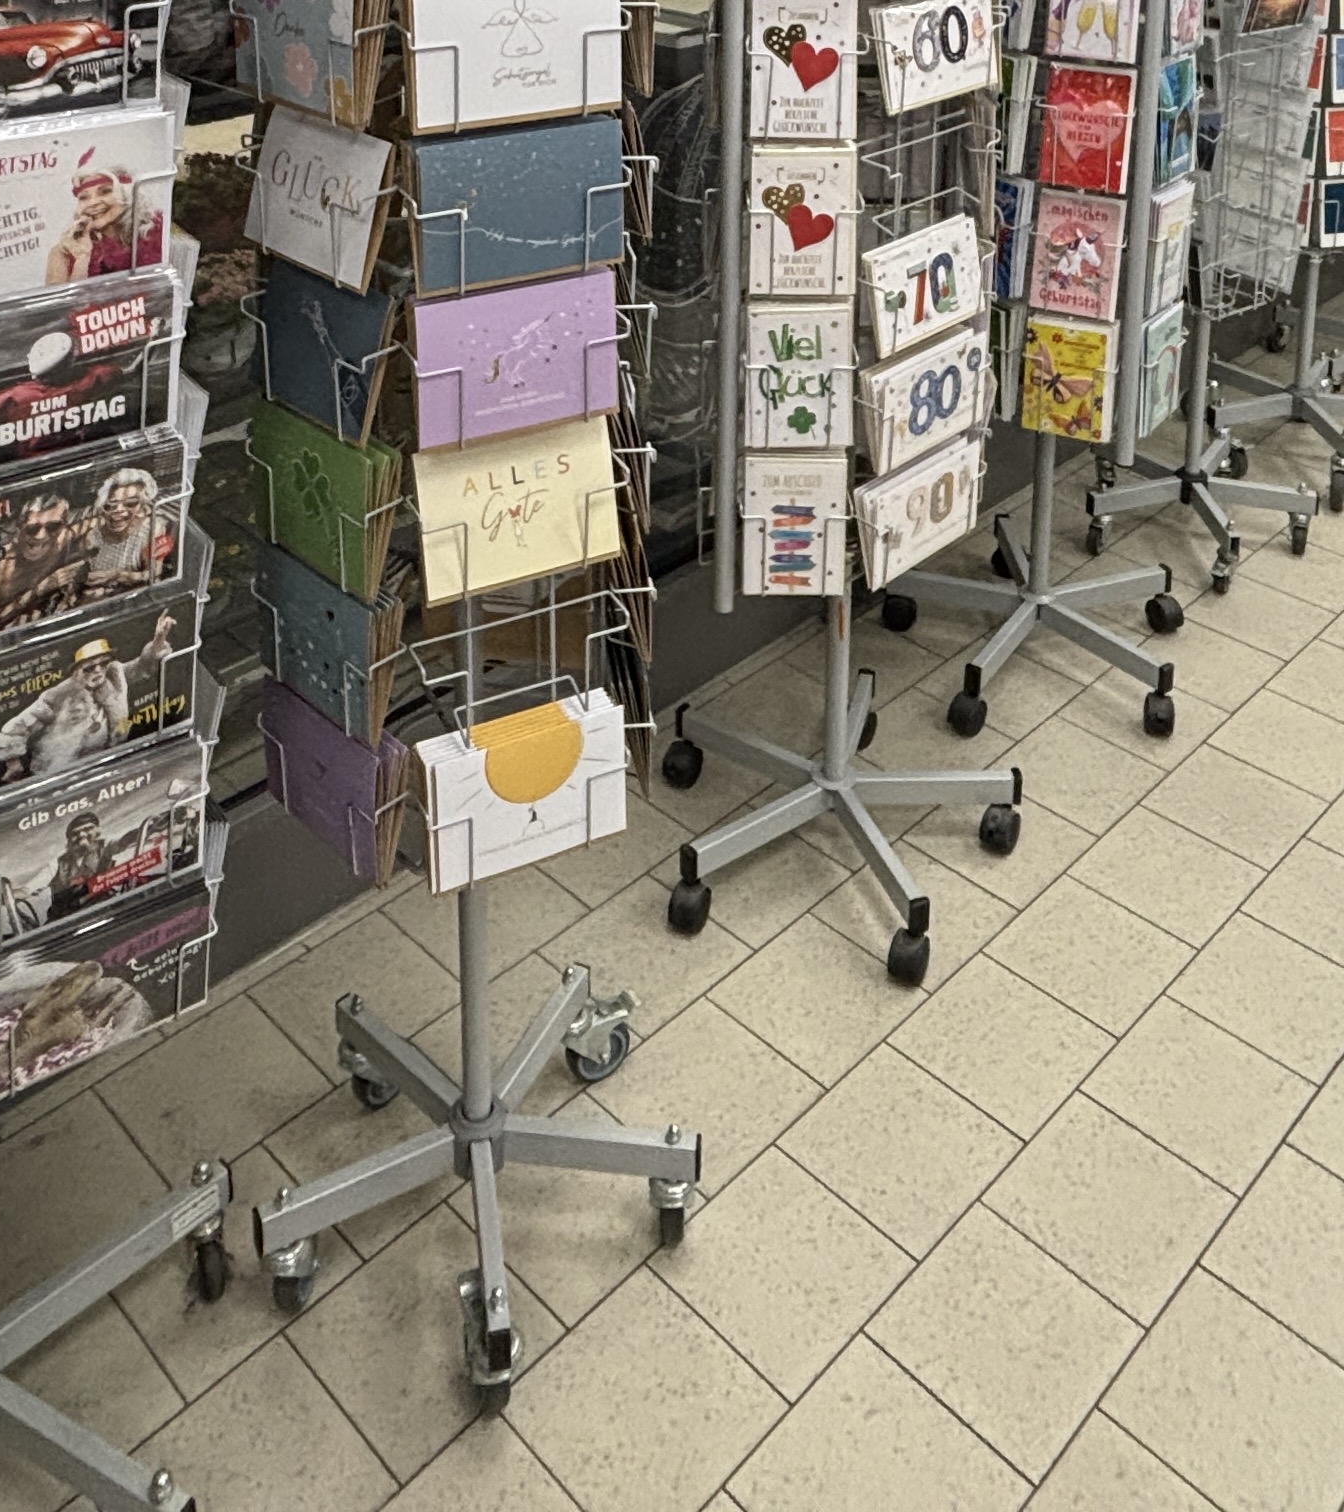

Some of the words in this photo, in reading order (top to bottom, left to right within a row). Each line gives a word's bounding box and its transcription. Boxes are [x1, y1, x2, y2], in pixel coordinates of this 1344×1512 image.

[912, 4, 969, 74] 60
[271, 148, 363, 215] GLÜCK
[1050, 205, 1109, 222] magischen
[906, 251, 958, 326] 70
[1038, 287, 1104, 318] Geburtstag
[75, 296, 146, 334] TOUCH
[79, 317, 147, 356] DOWN
[768, 323, 823, 363] Viel
[30, 394, 68, 414] ZUM
[758, 364, 833, 411] Glück
[908, 364, 962, 437] 80
[462, 452, 572, 498] ALLES
[761, 474, 782, 489] ZUM
[906, 470, 955, 536] 90
[18, 811, 50, 832] Gib
[54, 796, 94, 818] Gas,
[97, 771, 152, 804] Alter!
